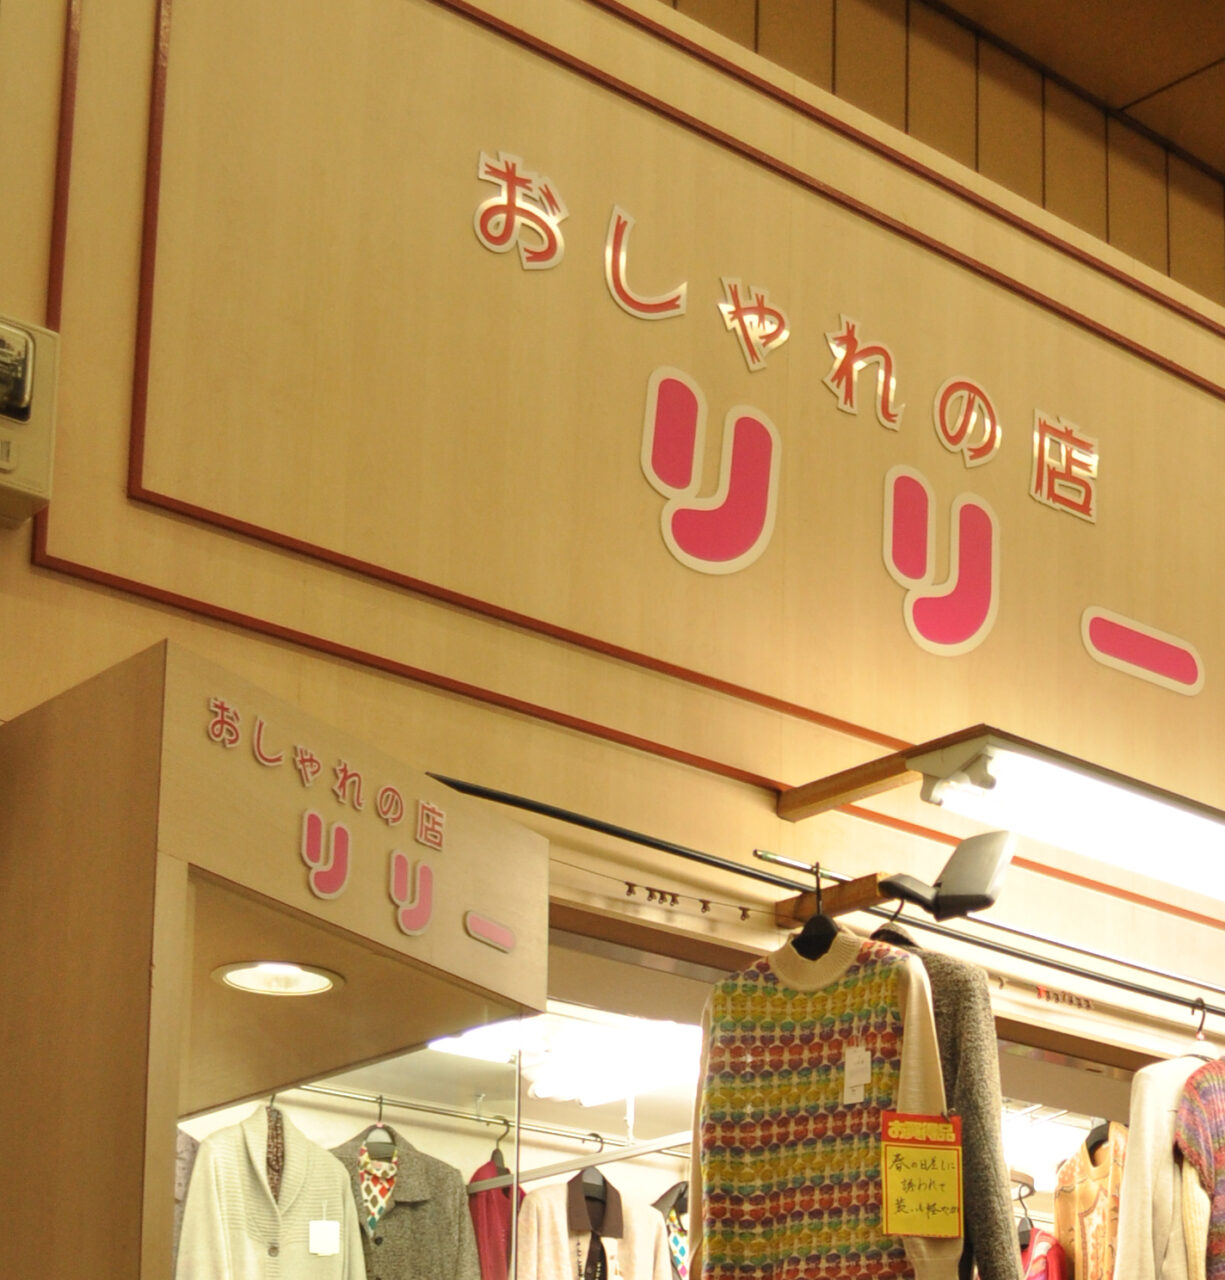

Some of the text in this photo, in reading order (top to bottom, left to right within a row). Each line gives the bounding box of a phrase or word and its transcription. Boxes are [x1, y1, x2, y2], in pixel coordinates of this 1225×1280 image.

[474, 150, 1100, 523] おしゃれの店
[641, 366, 1204, 696] リリー
[208, 697, 445, 850] おしゃれの店
[301, 808, 516, 954] リリー
